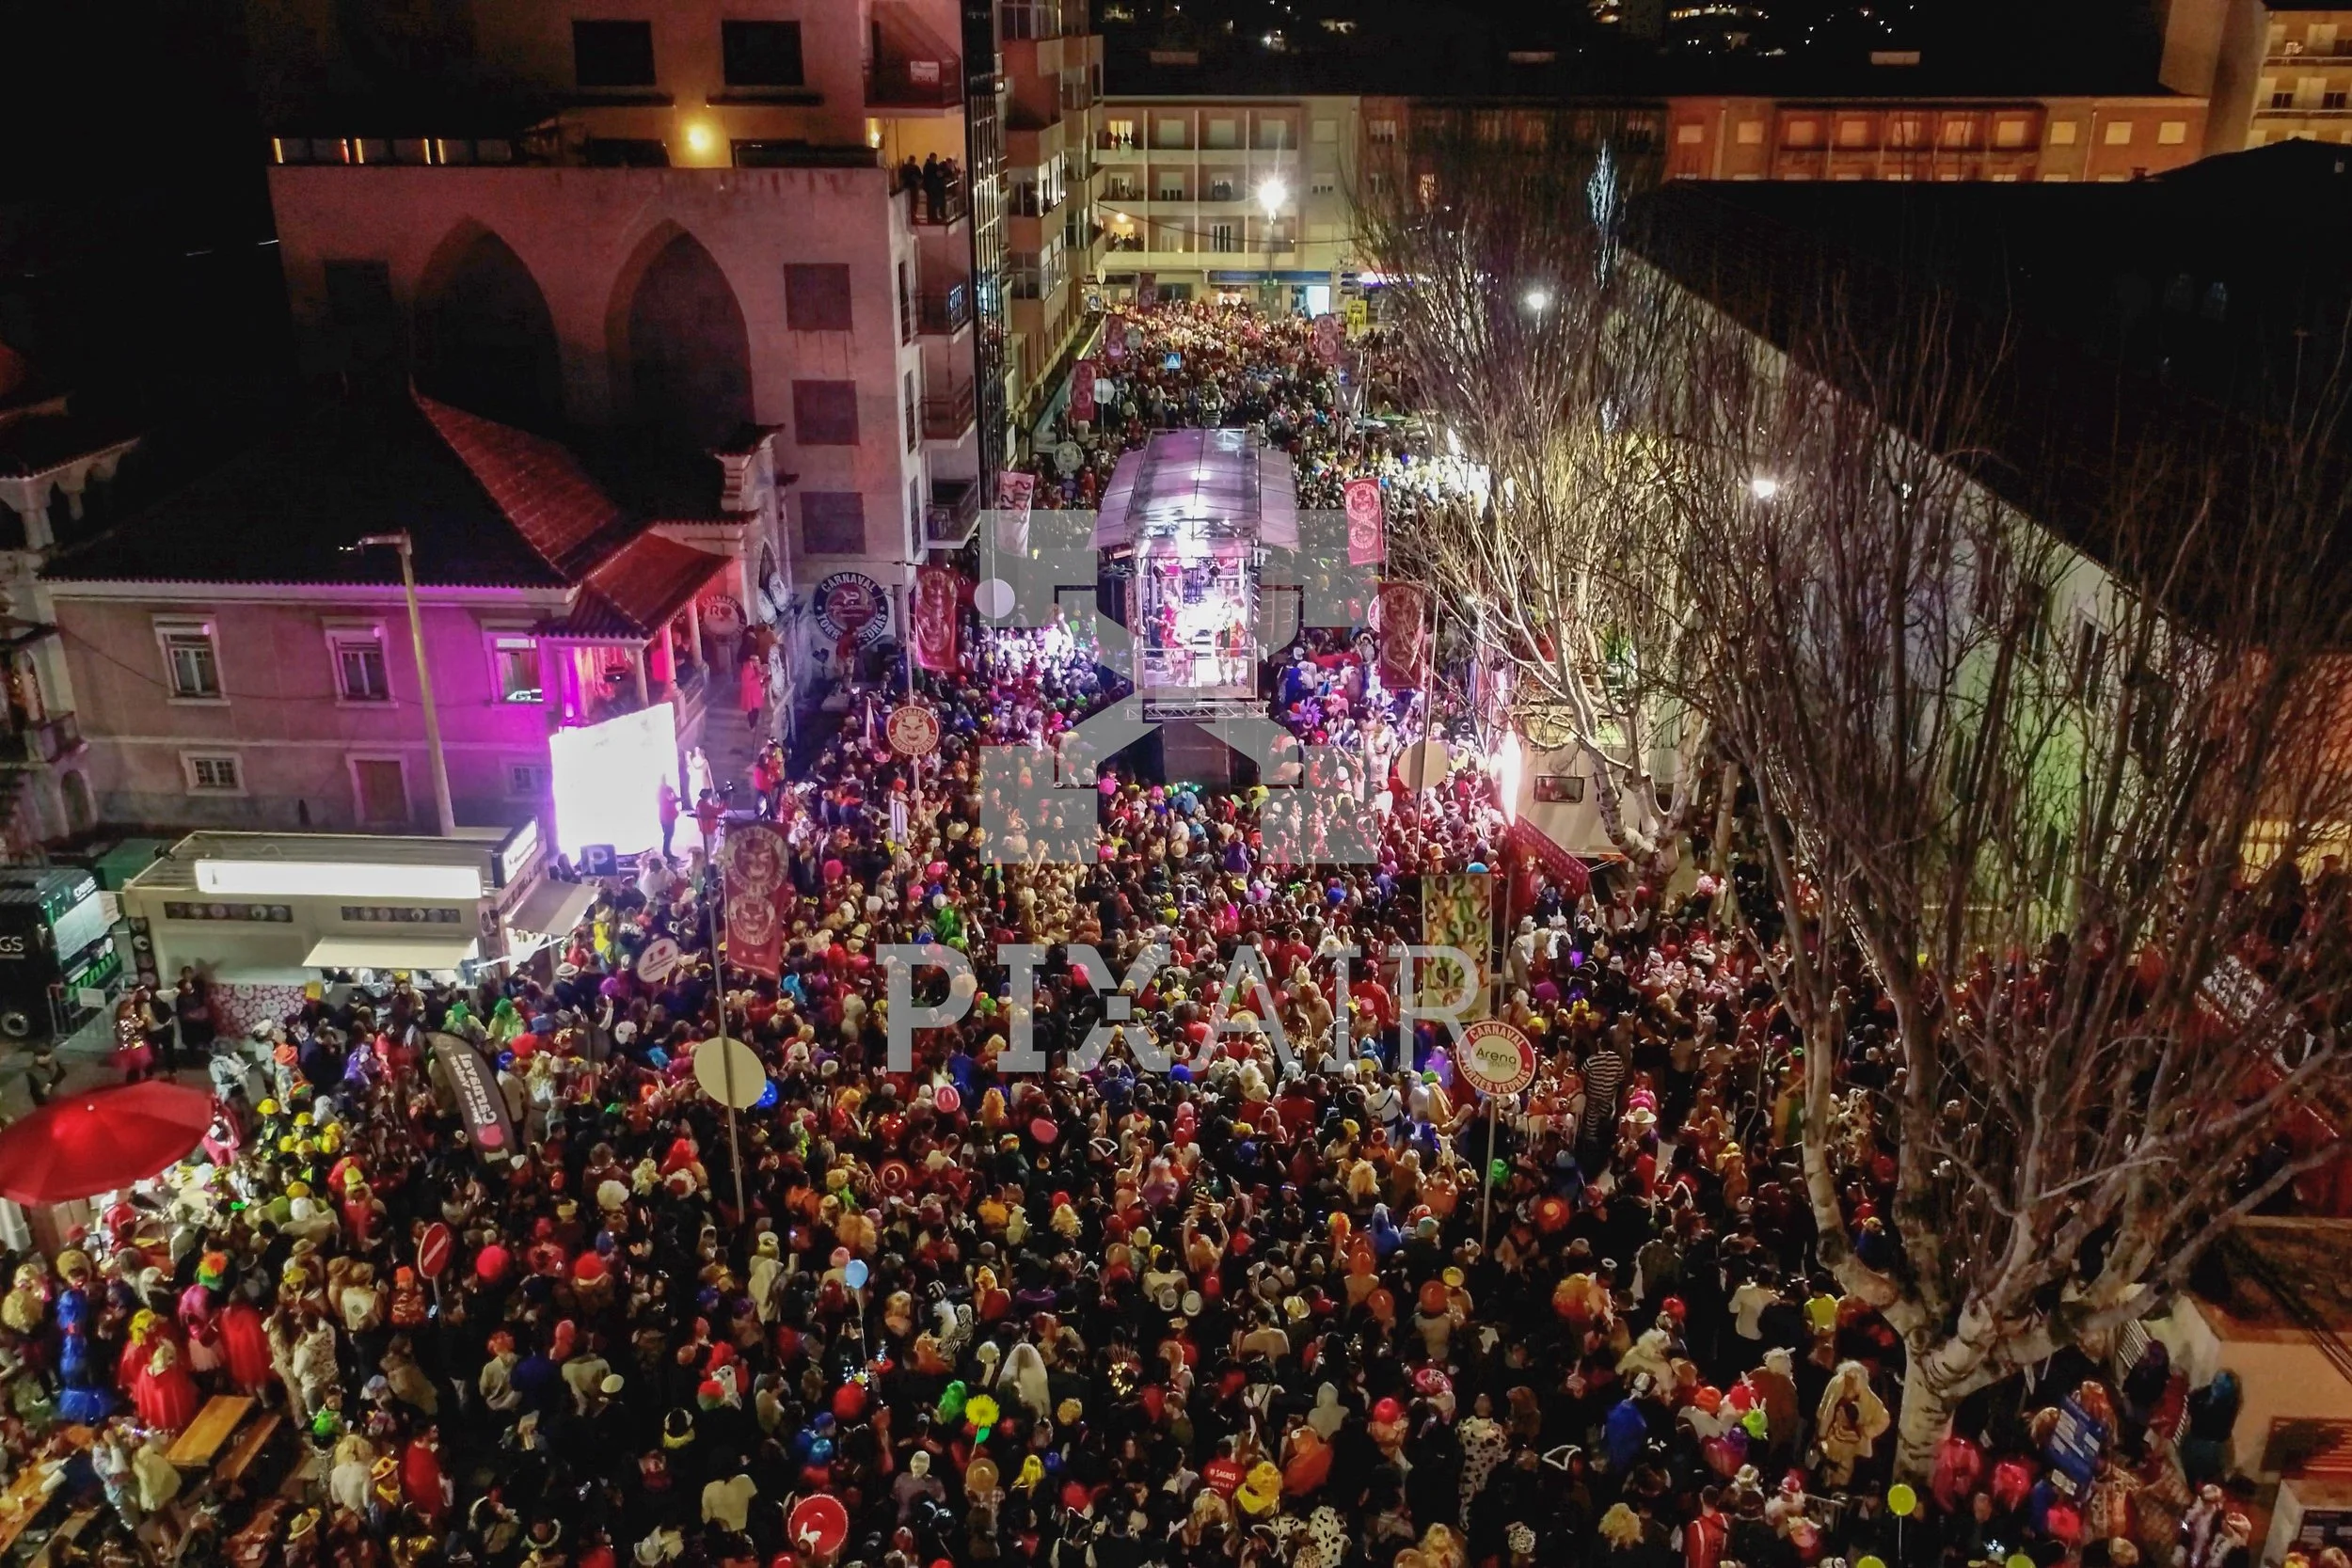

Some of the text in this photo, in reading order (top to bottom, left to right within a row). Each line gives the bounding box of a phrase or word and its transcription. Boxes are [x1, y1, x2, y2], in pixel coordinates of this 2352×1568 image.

[821, 573, 876, 593] CARNAVAL
[587, 847, 608, 874] P
[1470, 1025, 1525, 1049] CARNAVAL
[1476, 1047, 1517, 1065] Arena
[1461, 1060, 1531, 1093] TORRES VEDRAS
